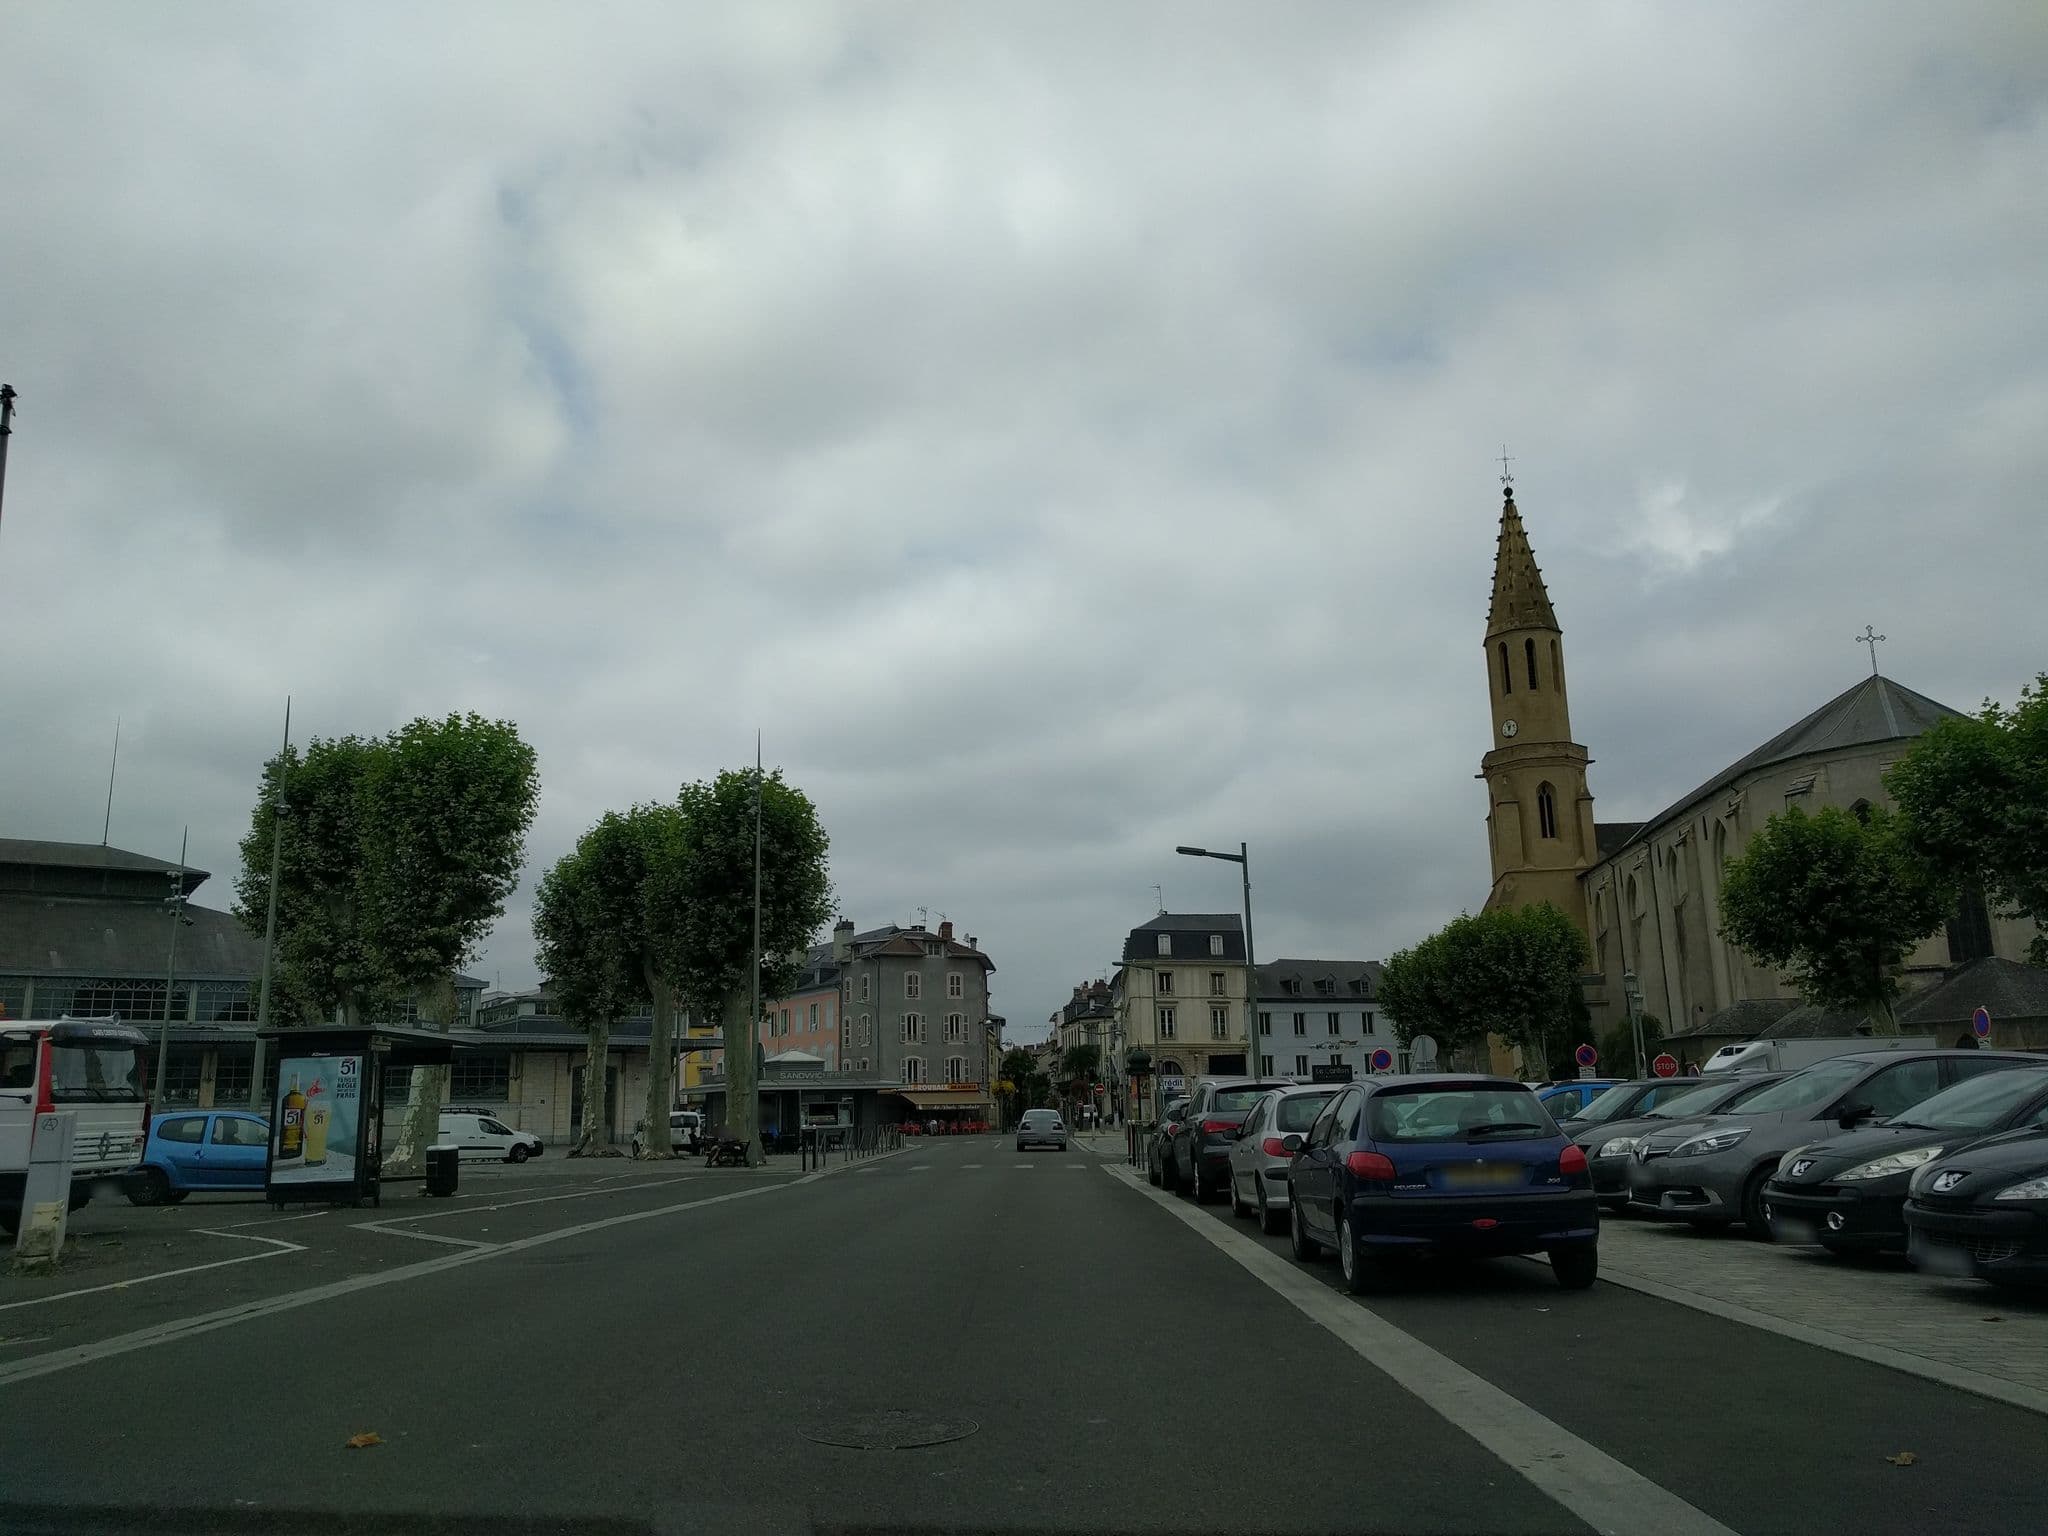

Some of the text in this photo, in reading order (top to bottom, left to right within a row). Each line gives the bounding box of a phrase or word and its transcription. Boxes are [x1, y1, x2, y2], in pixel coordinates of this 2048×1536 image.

[340, 1061, 357, 1075] 51
[286, 1112, 299, 1124] 51
[314, 1114, 324, 1125] 51
